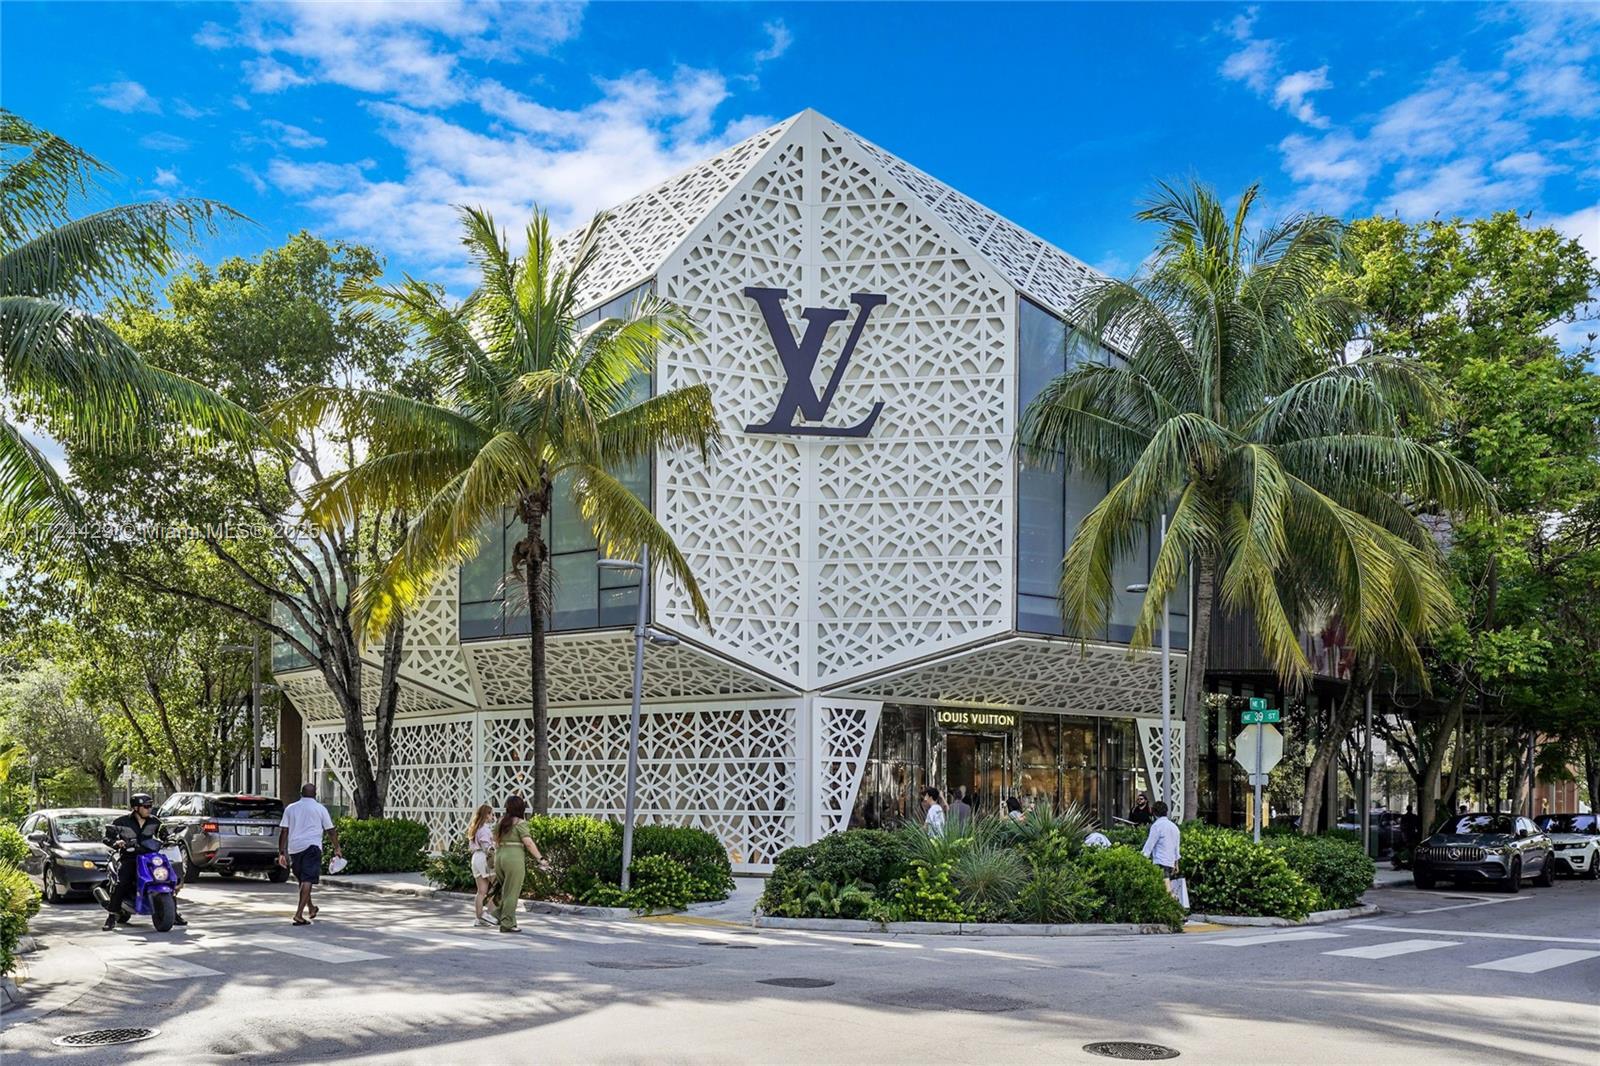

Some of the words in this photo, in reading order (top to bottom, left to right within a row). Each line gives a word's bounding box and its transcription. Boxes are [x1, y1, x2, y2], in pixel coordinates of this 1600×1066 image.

[744, 286, 887, 438] LV
[938, 711, 969, 724] LOUIS
[971, 713, 1015, 726] VUITTON
[1254, 711, 1264, 722] 39
[1268, 712, 1276, 720] ST
